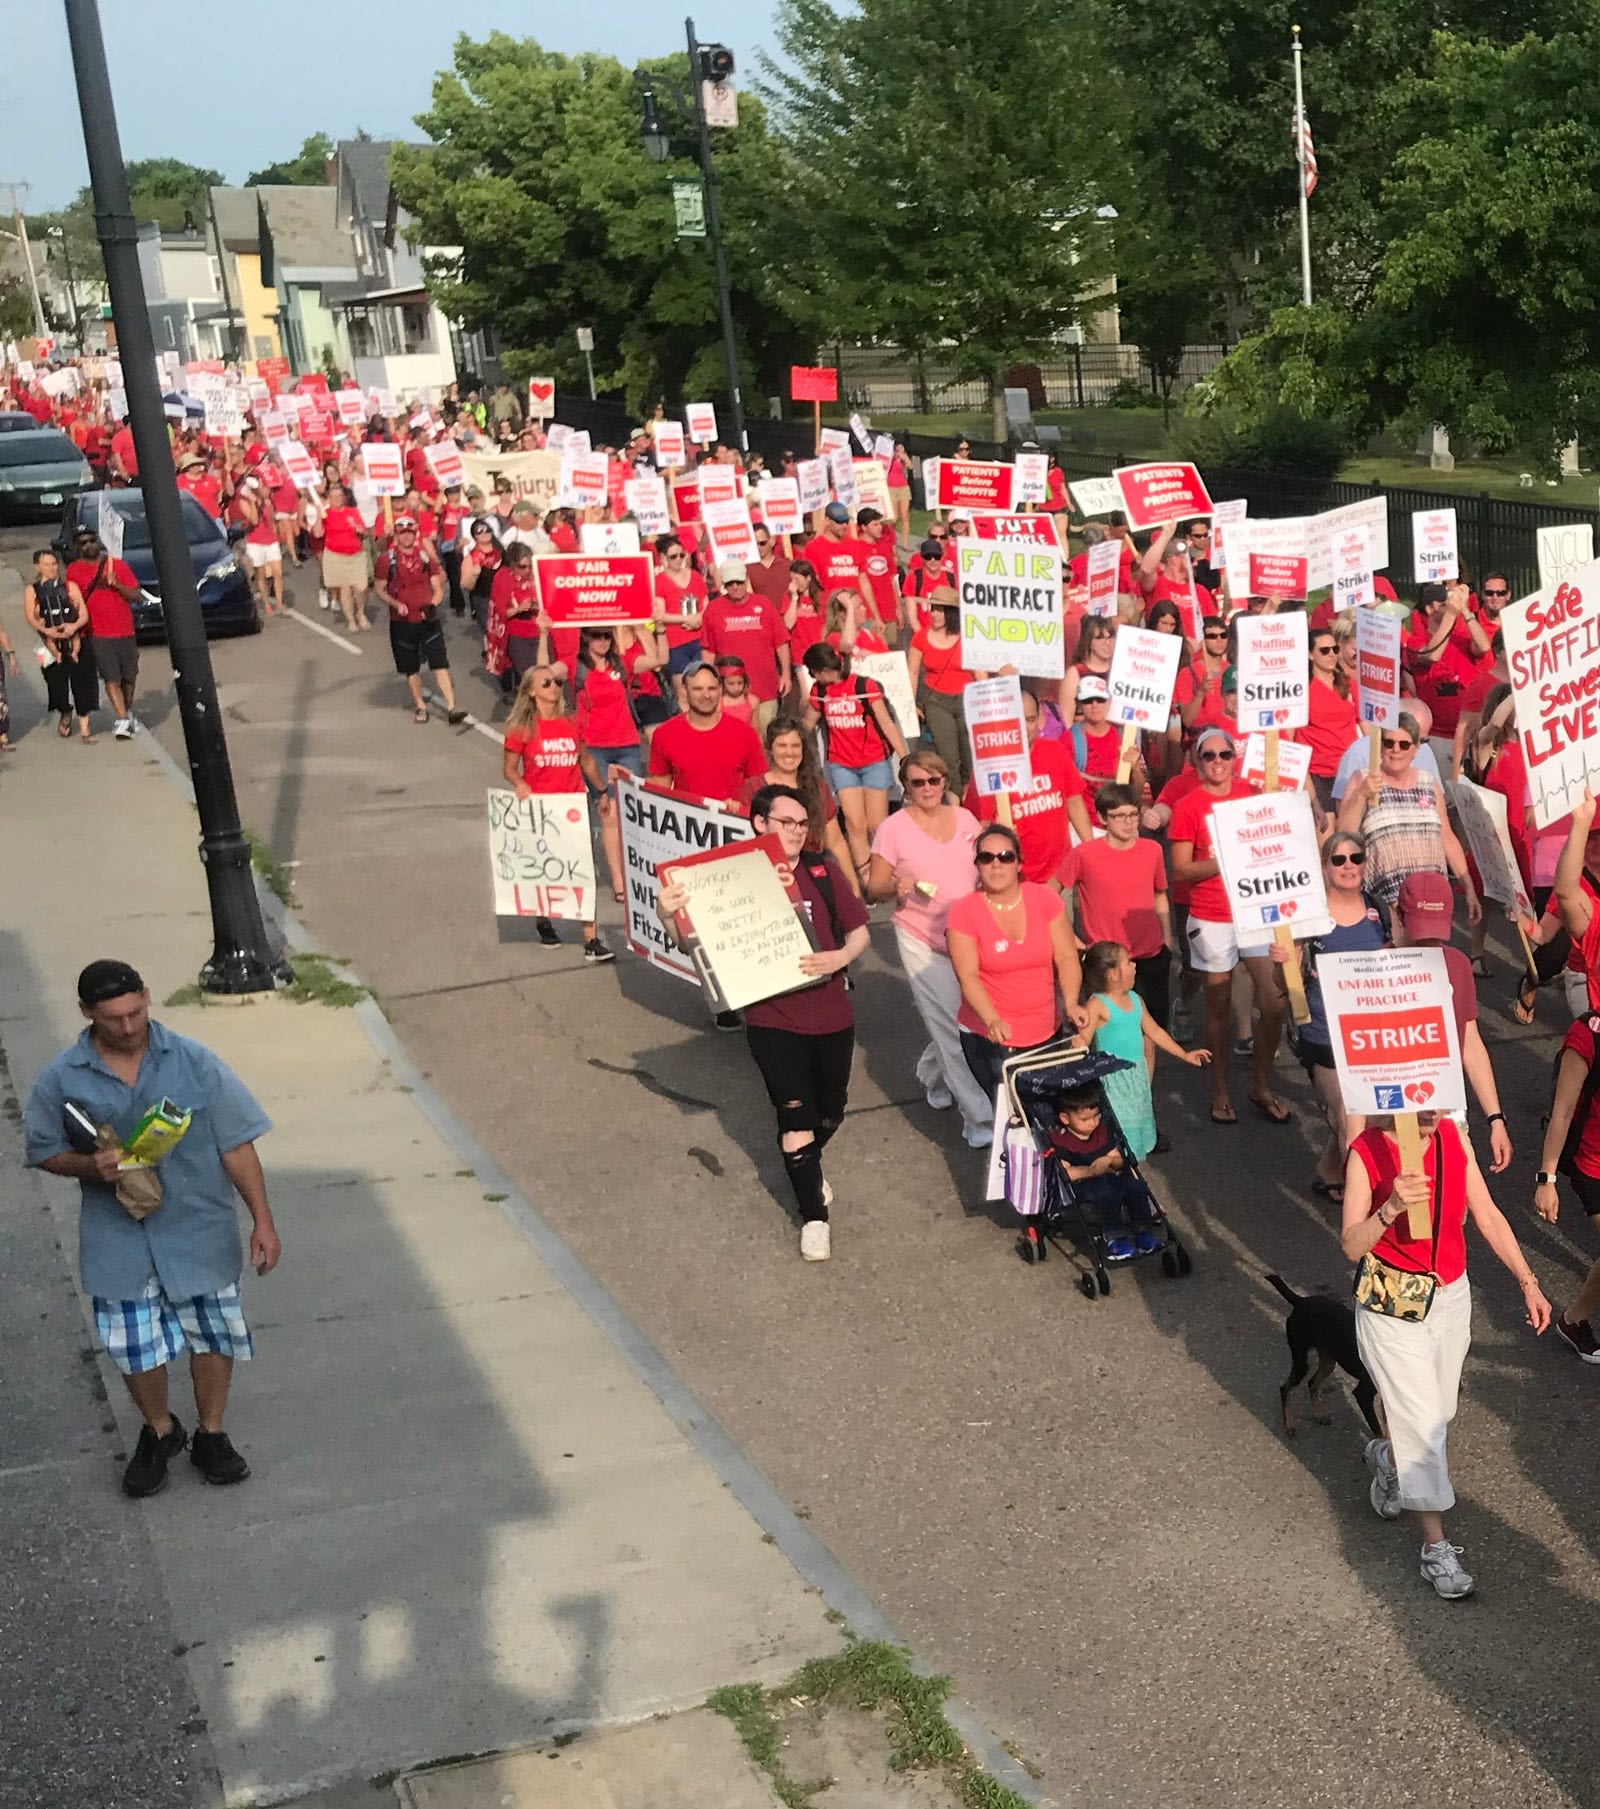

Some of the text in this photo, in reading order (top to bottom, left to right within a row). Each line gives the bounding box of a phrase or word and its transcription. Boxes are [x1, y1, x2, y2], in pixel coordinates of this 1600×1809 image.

[369, 466, 399, 478] STRIKE
[573, 472, 604, 487] STRIKE
[952, 465, 1000, 478] PATIENTS
[1133, 468, 1185, 484] PATIENTS
[960, 475, 993, 487] Before
[1148, 480, 1183, 494] Before
[952, 486, 998, 498] PROFITS!
[1143, 490, 1194, 508] PROFITS!
[768, 502, 796, 513] STRIKE
[715, 525, 750, 541] STRIKE
[995, 517, 1037, 534] PUT
[1419, 550, 1454, 564] Strike
[1542, 531, 1590, 567] NICU
[576, 561, 610, 574] FAIR
[961, 549, 1055, 582] FAIR
[1256, 556, 1299, 568] PATIENTS
[1263, 567, 1292, 577] Before
[554, 574, 634, 588] CONTRACT
[1091, 574, 1114, 592] STRIKE
[1258, 576, 1296, 587] PROFITS!
[1337, 571, 1370, 591] Strike
[577, 591, 617, 604] NOW!
[962, 582, 1055, 613] CONTRACT
[1525, 582, 1583, 641] Safe
[965, 614, 1061, 645] NOW!
[1260, 622, 1286, 634] Safe
[1137, 634, 1161, 646] Safe
[1251, 637, 1296, 650] Staffing
[1126, 646, 1167, 664] Staffing
[1259, 655, 1288, 666] Now
[1130, 659, 1157, 675] Now
[1360, 661, 1393, 685] STRIKE
[1113, 681, 1166, 705] Strike
[1244, 681, 1304, 702] Strike
[828, 701, 856, 714] MICU
[542, 737, 577, 752] MICU
[976, 729, 1020, 750] STRIKE
[534, 753, 580, 768] STRON
[1012, 791, 1063, 819] STRONG
[1245, 805, 1276, 821] Safe
[489, 794, 560, 836] $84K
[624, 792, 747, 852] SHAME
[1236, 821, 1292, 841] Staffing
[1250, 841, 1285, 858] Now
[497, 852, 589, 882] $30K
[688, 867, 742, 892] Workers
[1237, 869, 1311, 899] Strike
[514, 884, 585, 919] LIE!
[1338, 951, 1423, 966] University of Vermont
[1354, 962, 1412, 974] Medical Center
[1337, 971, 1433, 991] UNFAIR LABOR
[1356, 991, 1420, 1007] PRACTICE
[1350, 1022, 1441, 1051] STRIKE
